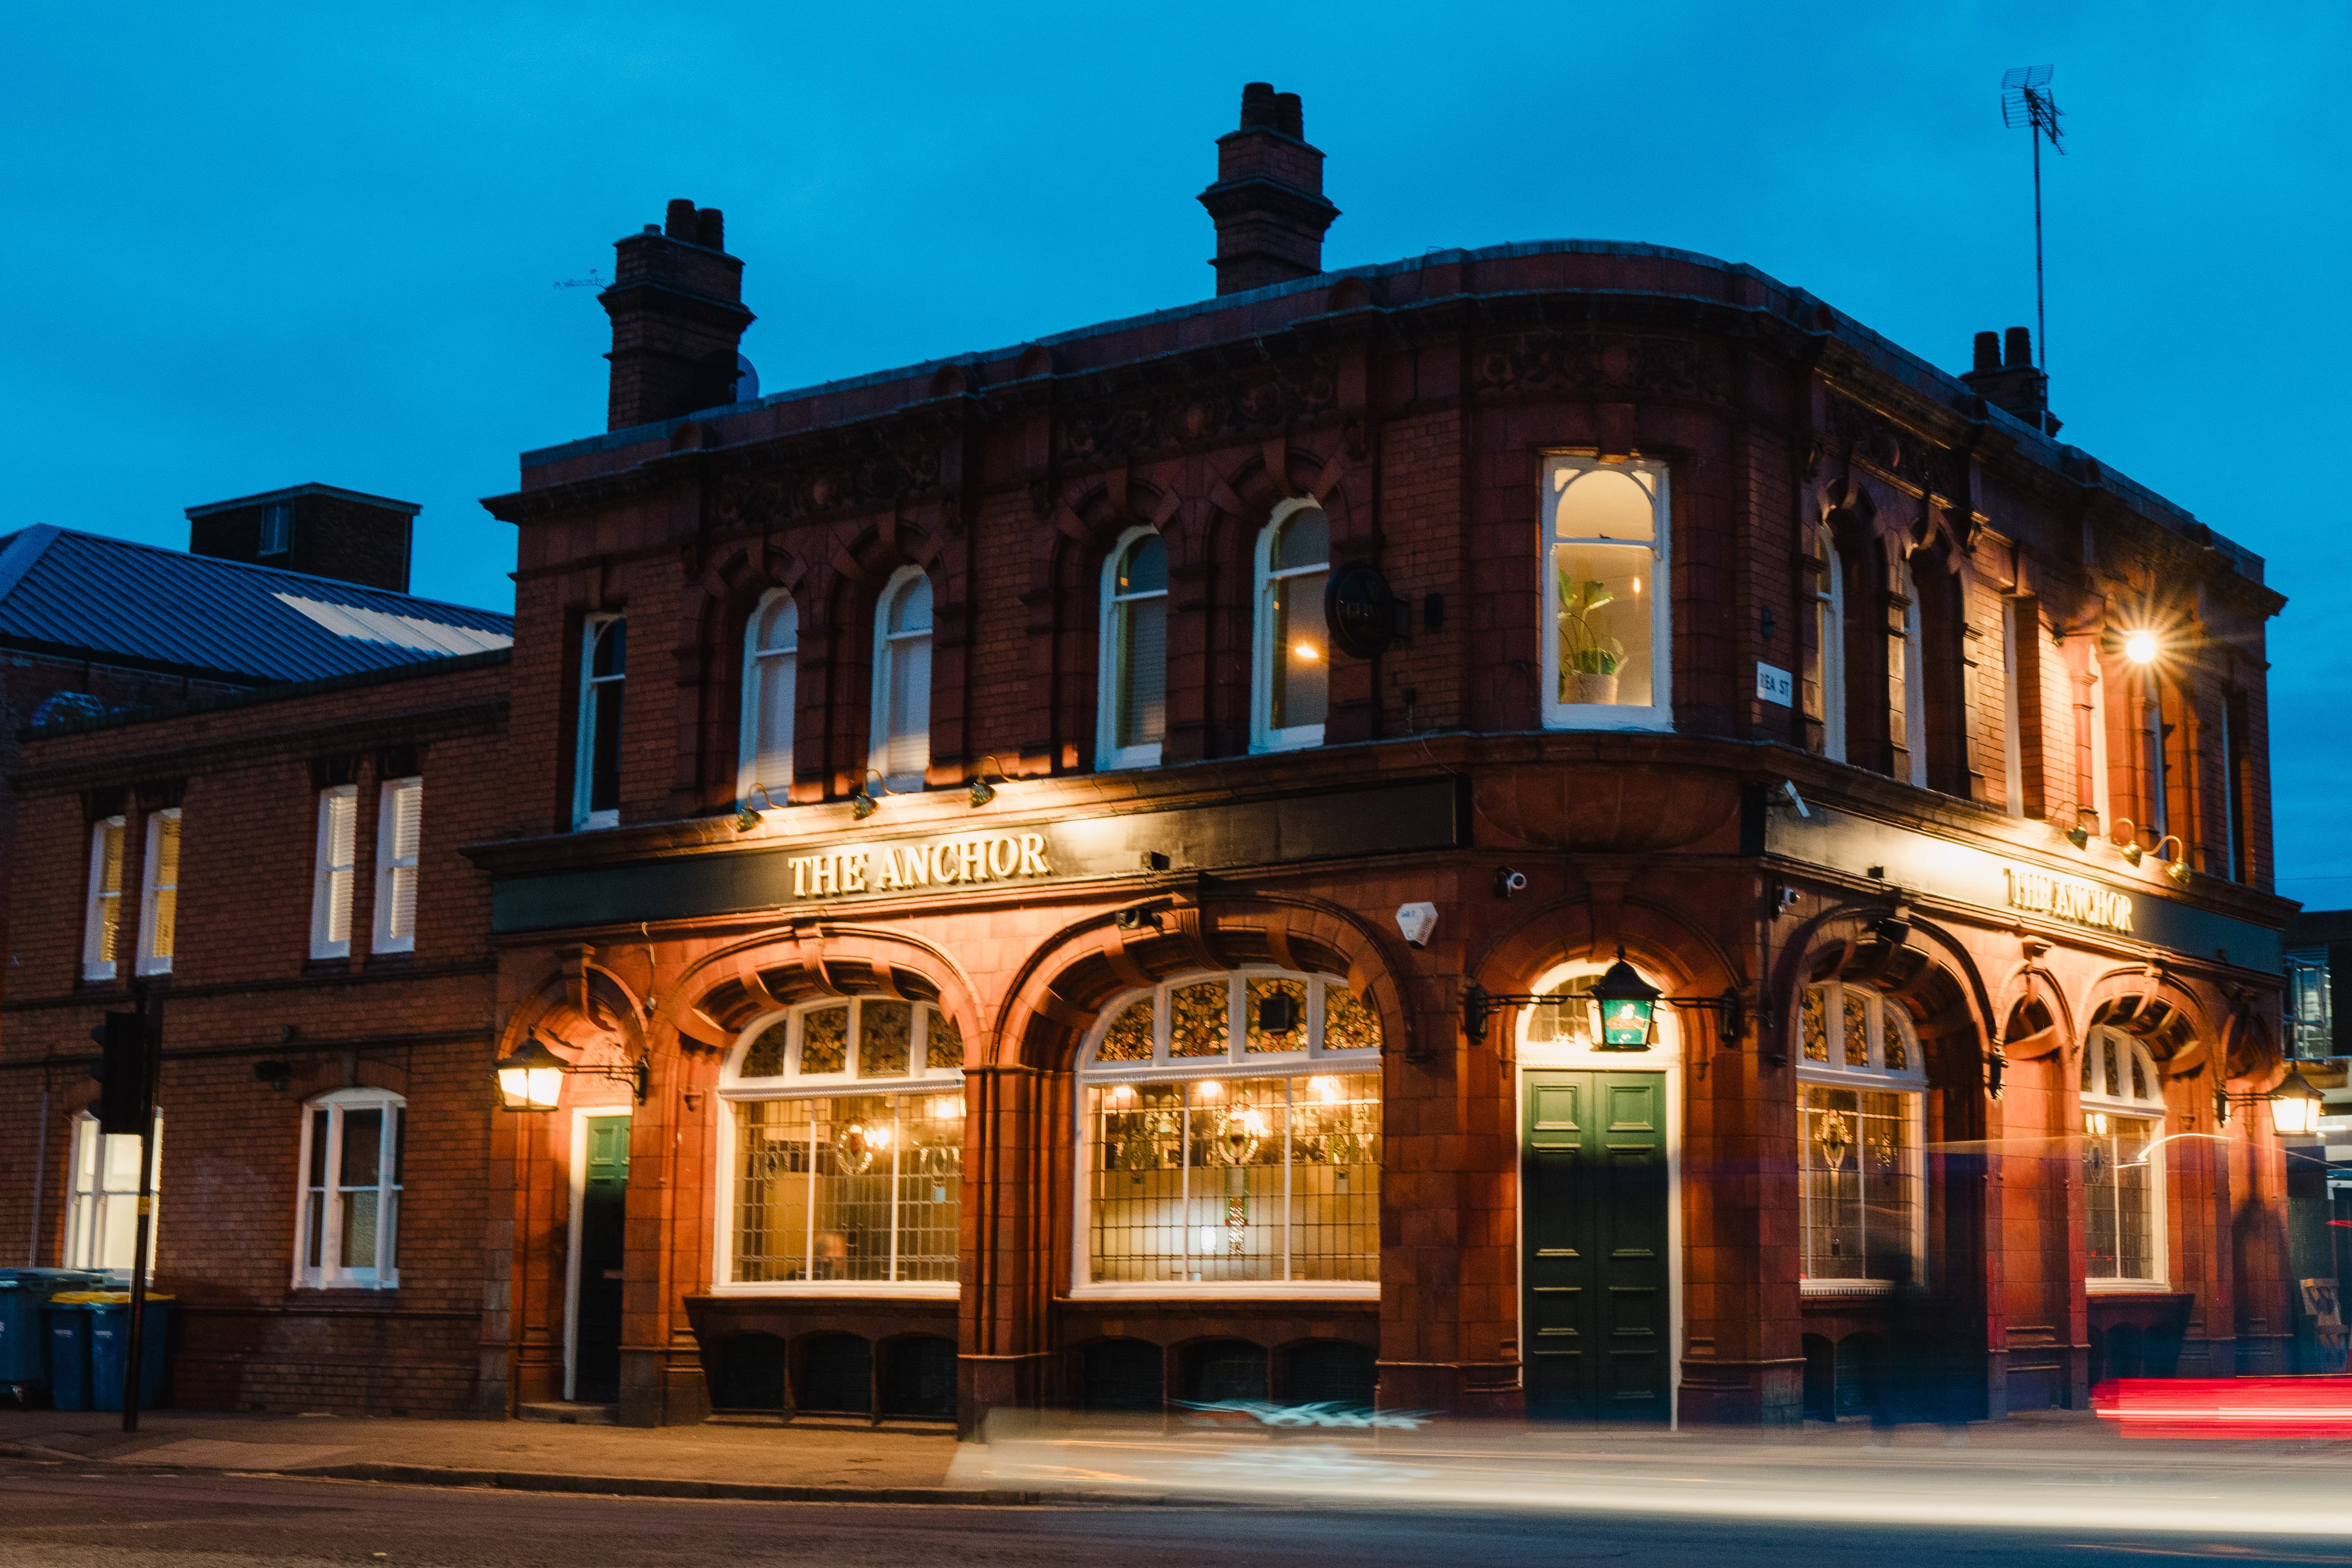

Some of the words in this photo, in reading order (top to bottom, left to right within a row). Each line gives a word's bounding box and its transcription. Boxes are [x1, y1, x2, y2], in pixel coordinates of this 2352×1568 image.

[1779, 679, 1789, 698] ST
[788, 852, 868, 897] THE
[874, 832, 1052, 890] ANCHOR
[2003, 868, 2052, 911] THE
[2054, 880, 2134, 932] ANCHOR
